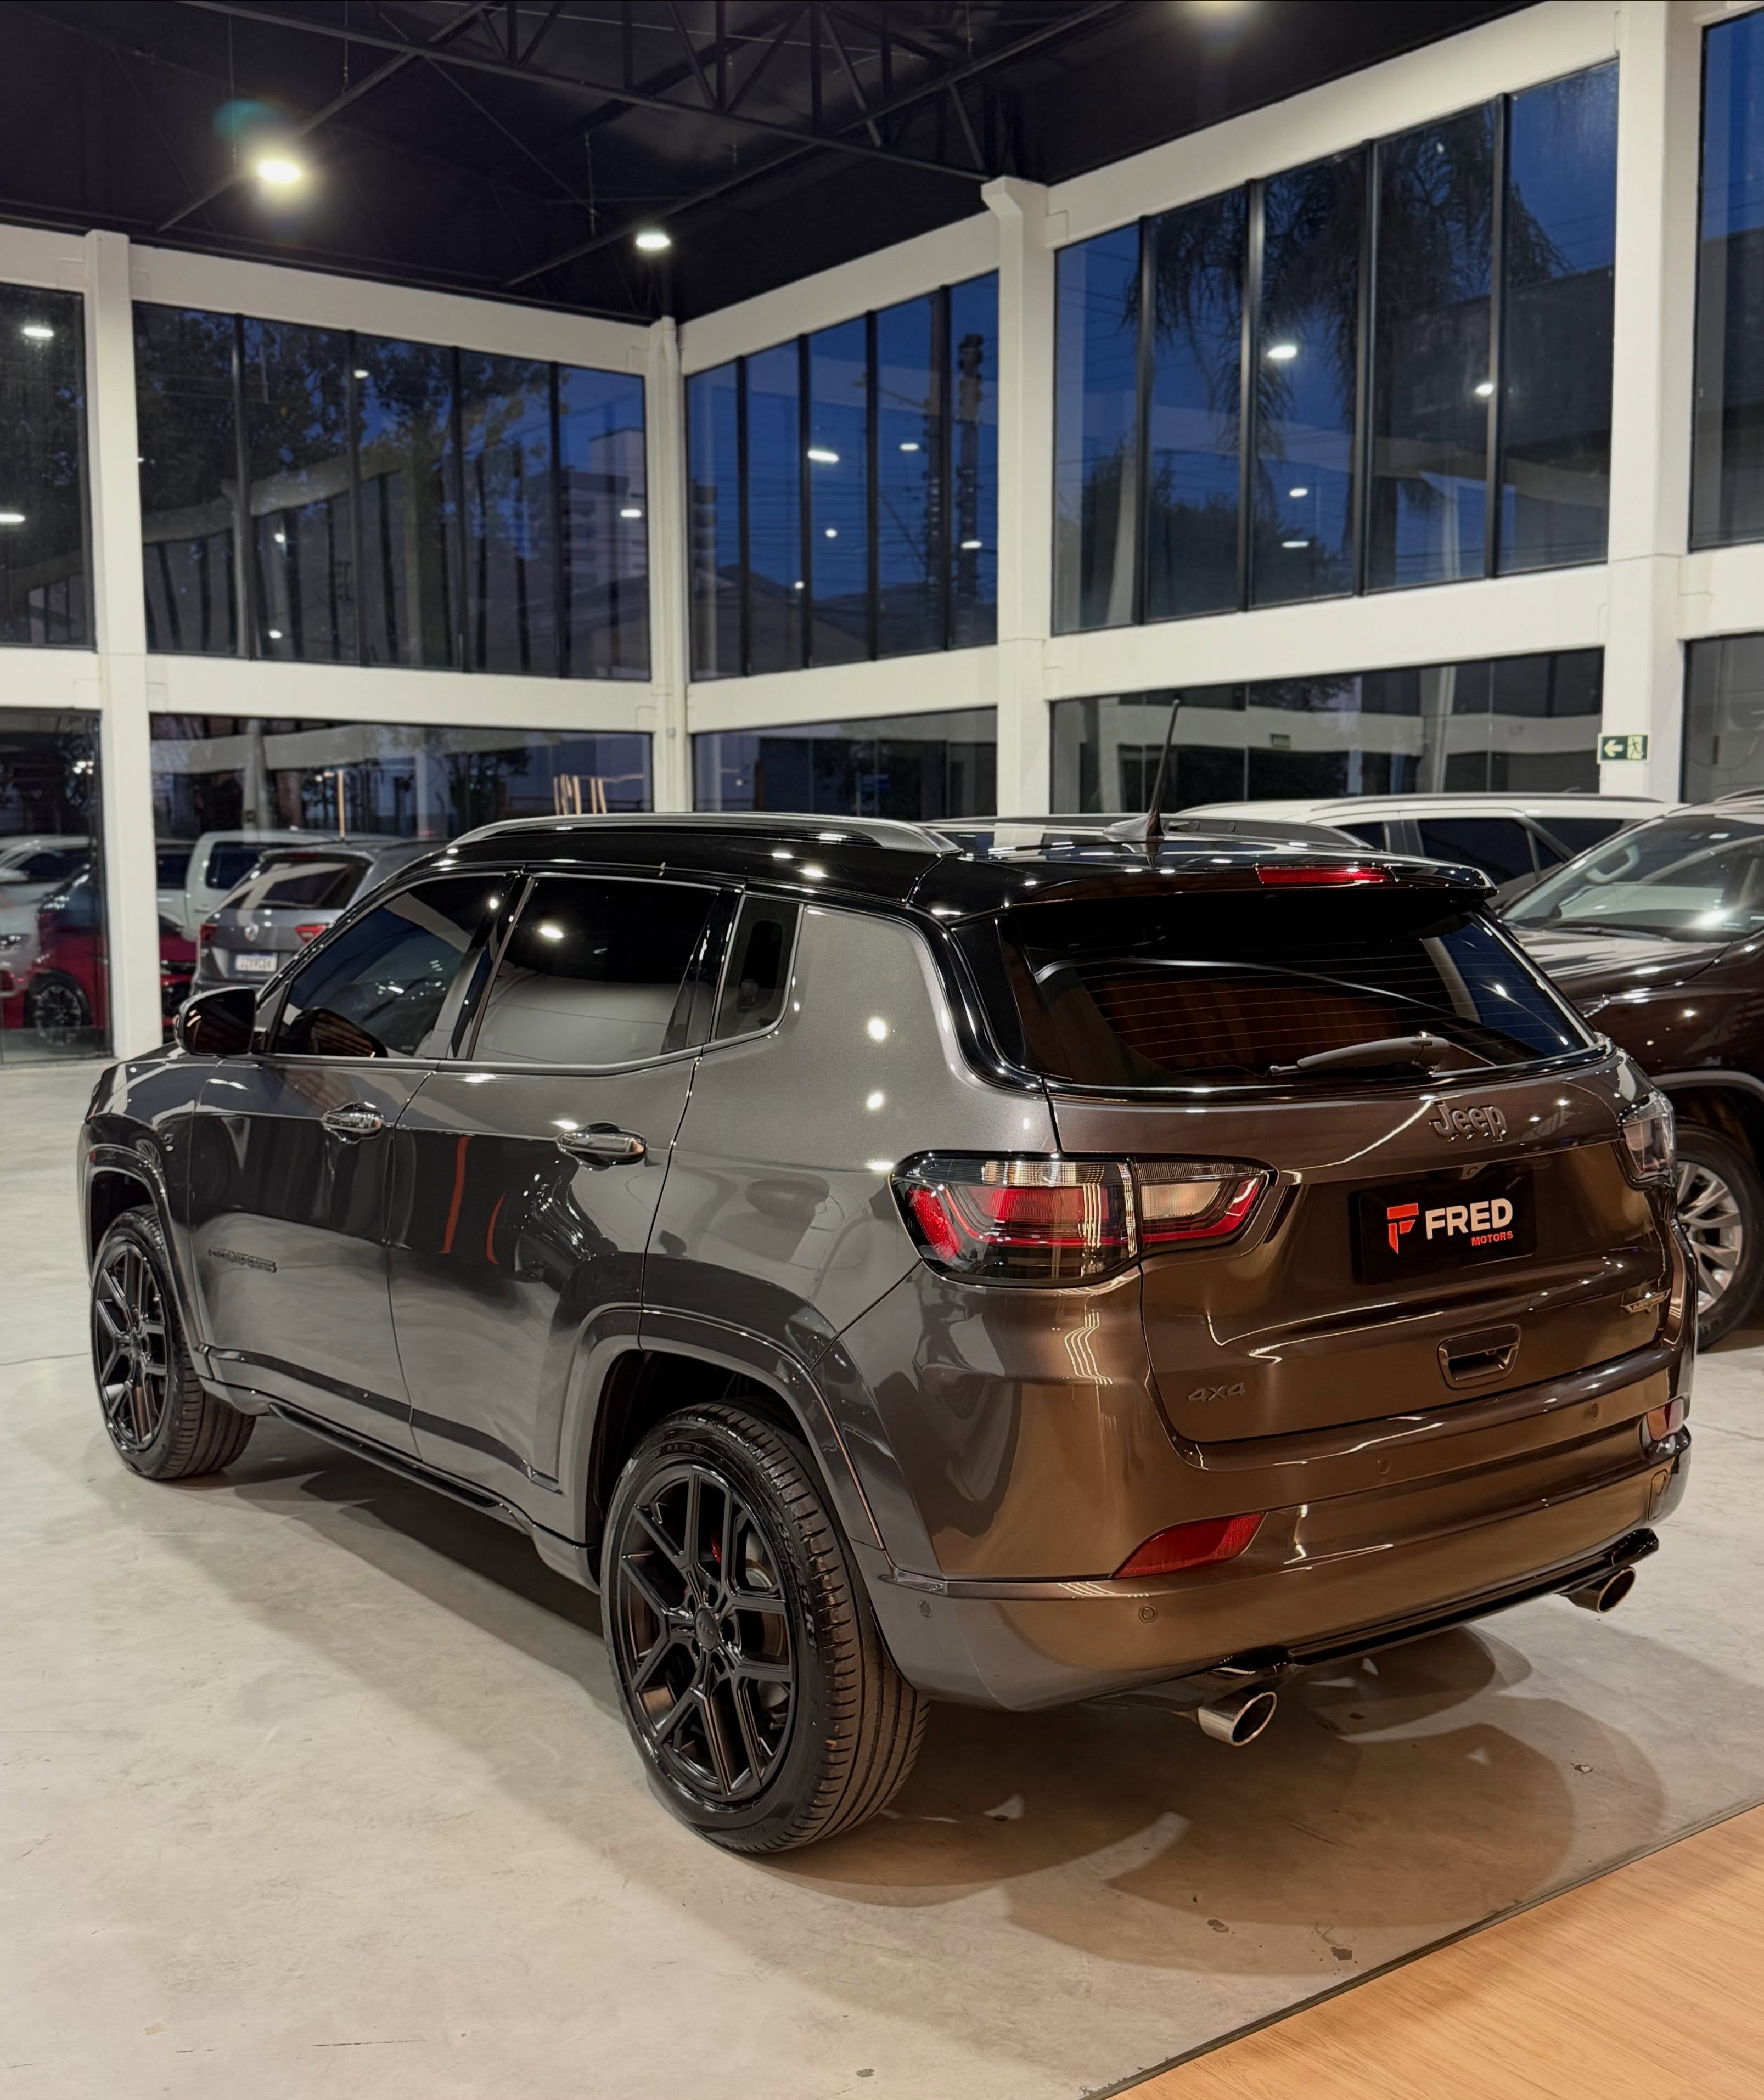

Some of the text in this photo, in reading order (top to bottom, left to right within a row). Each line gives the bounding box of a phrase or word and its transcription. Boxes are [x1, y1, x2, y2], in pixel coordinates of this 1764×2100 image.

[1429, 1101, 1507, 1142] Jeep
[1425, 1198, 1513, 1240] FRED
[1471, 1231, 1514, 1247] MOTORS
